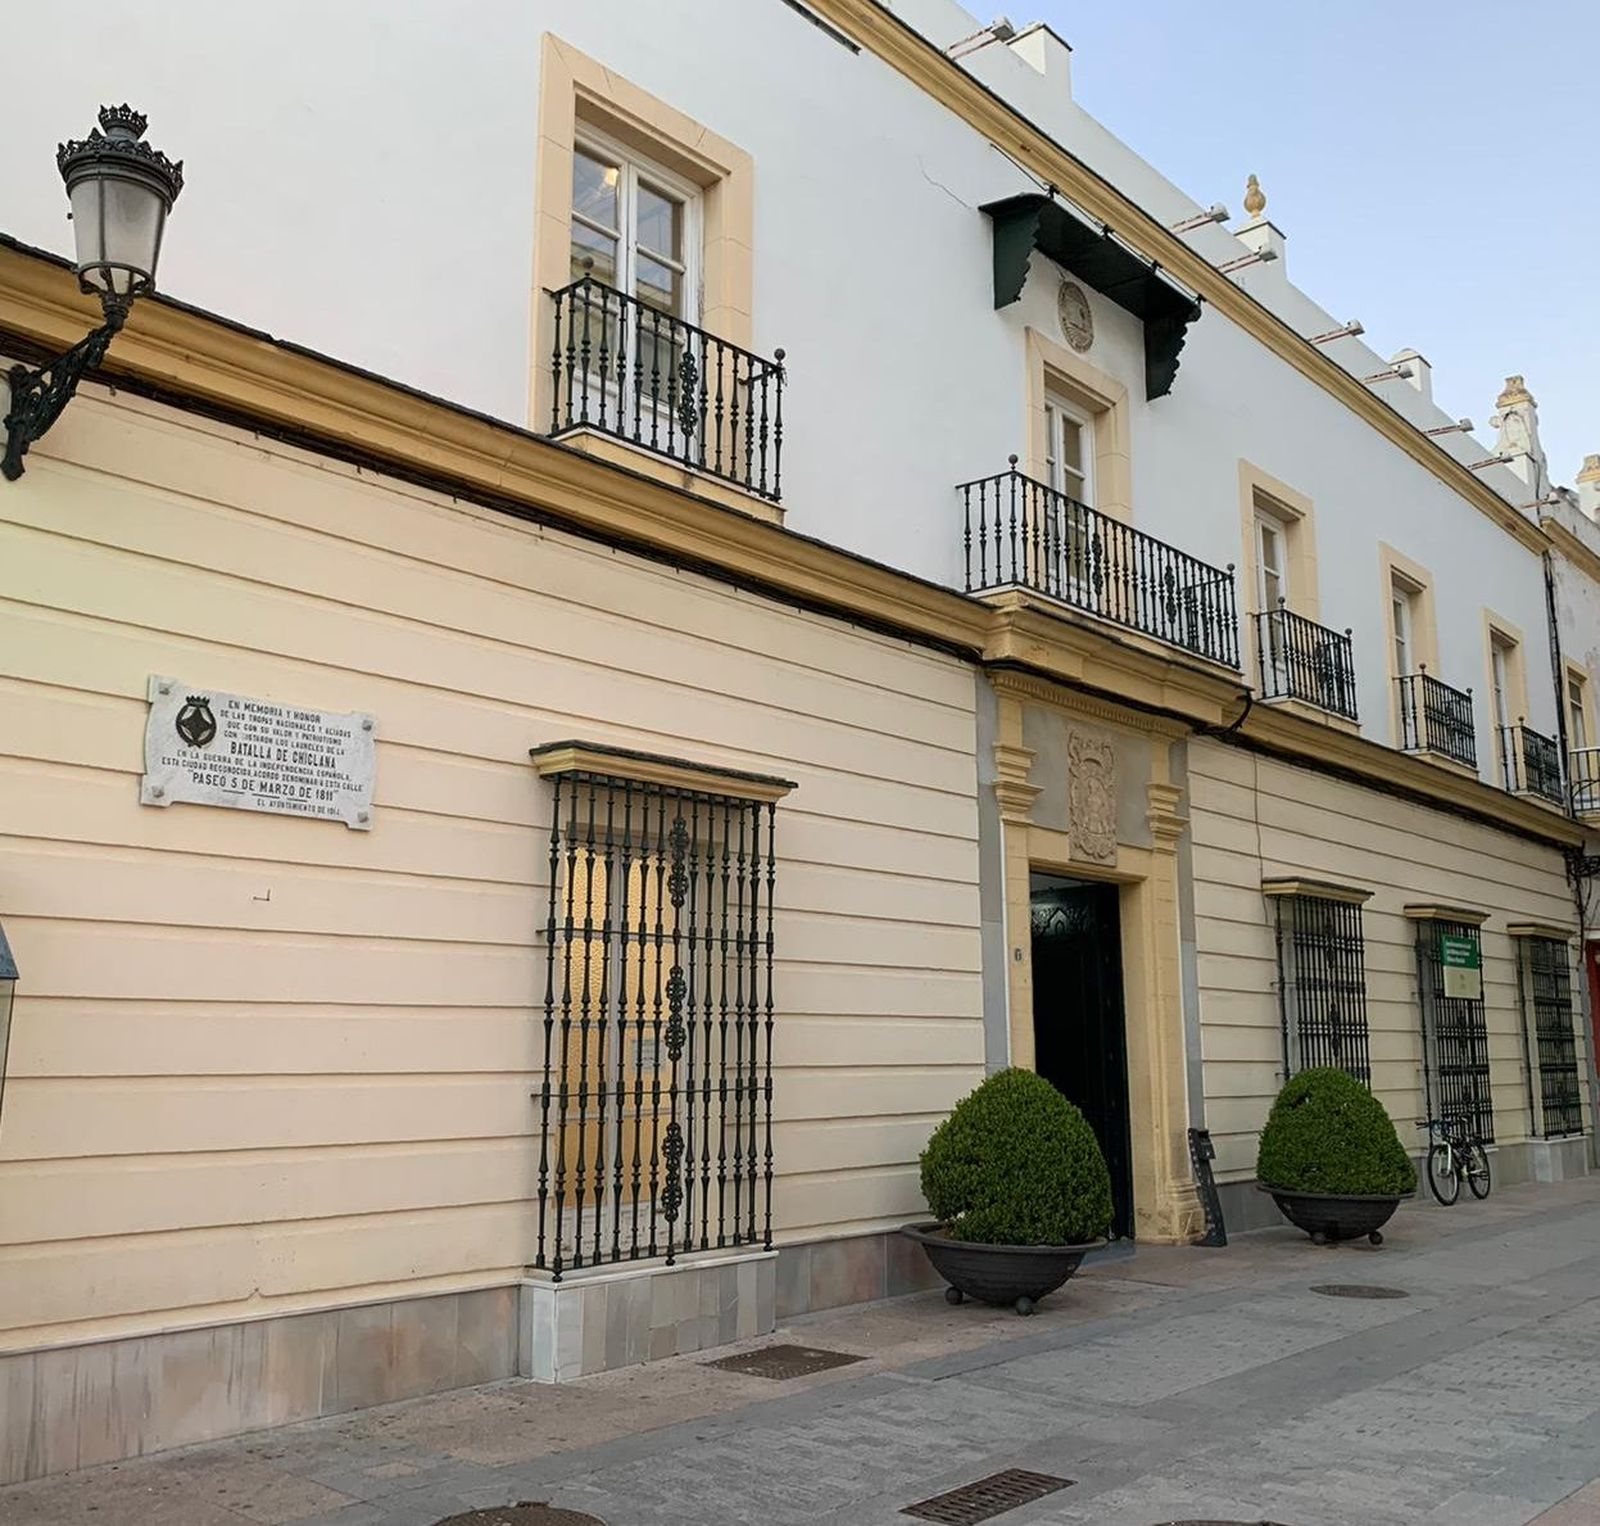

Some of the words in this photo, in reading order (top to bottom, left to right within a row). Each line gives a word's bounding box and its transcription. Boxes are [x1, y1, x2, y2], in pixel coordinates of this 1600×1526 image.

[220, 709, 229, 718] DE
[232, 712, 245, 720] LAS
[249, 714, 273, 725] TROPAS
[276, 719, 316, 732] NACIONALES
[325, 728, 351, 738] ALIADAS
[228, 700, 240, 709] EN
[244, 703, 283, 717] MEMORIA
[293, 711, 321, 724] HONOR
[227, 721, 240, 730] QUE
[244, 723, 257, 732] CON
[261, 726, 270, 734] SU
[273, 728, 292, 737] VALOR
[302, 733, 342, 746] PATRIOTISMO
[231, 741, 271, 759] BATALLA
[276, 748, 288, 762] DE
[292, 751, 336, 769] CHICLANA
[275, 738, 288, 747] LOS
[291, 741, 324, 752] LAURELES
[326, 746, 335, 754] DE
[336, 748, 345, 756] LA
[162, 757, 179, 766] ESTA
[182, 759, 207, 770] CIUDAD
[281, 773, 318, 786] DENOMINAR
[325, 779, 341, 788] ESTA
[177, 749, 187, 757] EN
[190, 751, 199, 759] LA
[203, 753, 231, 764] GUERRA
[235, 758, 244, 766] DE
[259, 761, 314, 775] INDEPENDENCIA
[231, 777, 238, 788] 5
[241, 778, 256, 791] DE
[259, 781, 295, 796] MARZO
[298, 786, 312, 799] DE
[257, 798, 265, 806] EL
[317, 806, 325, 814] DE
